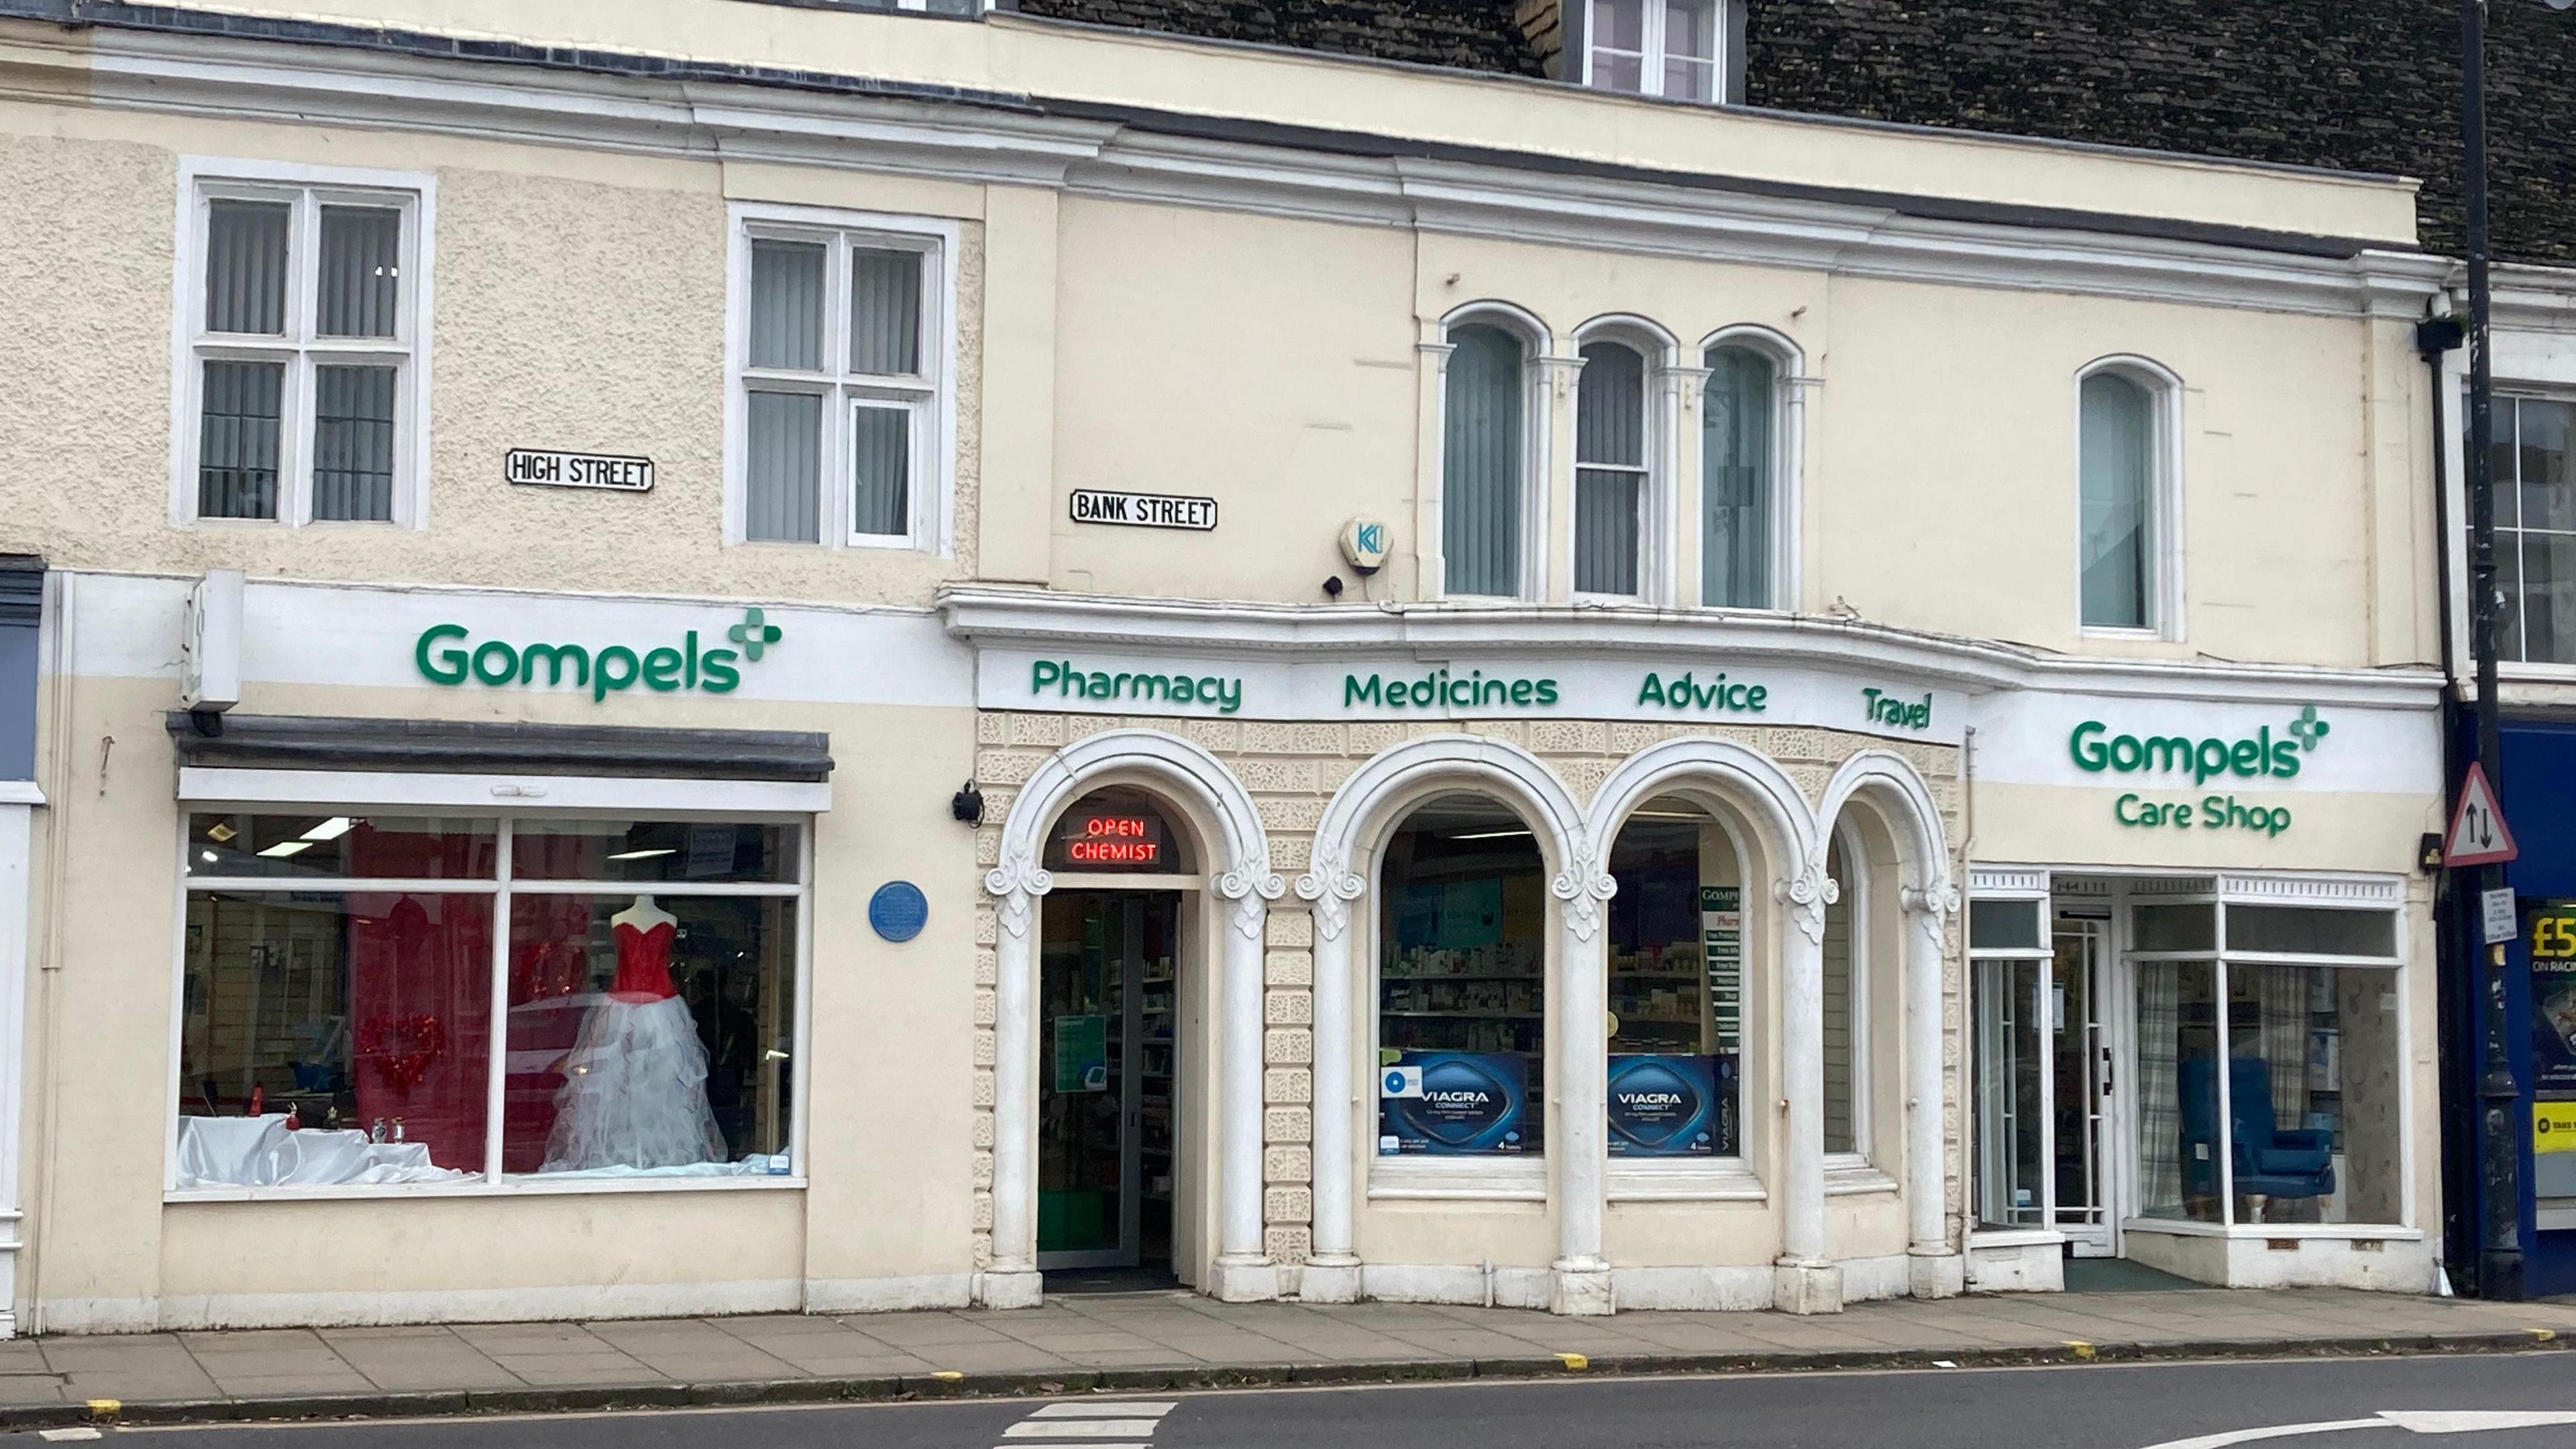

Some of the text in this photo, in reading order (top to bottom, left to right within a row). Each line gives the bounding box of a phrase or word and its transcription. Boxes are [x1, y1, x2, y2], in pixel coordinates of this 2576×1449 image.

[513, 454, 649, 486] HIGH STREET
[1077, 494, 1212, 525] BANK STREET
[415, 624, 741, 702] Gompels
[1032, 660, 1241, 713] Pharmacy
[1344, 669, 1558, 708] Medicines
[1639, 672, 1768, 712] Advice
[1864, 688, 1932, 729] Travel
[2070, 720, 2301, 785] Gompels
[1088, 818, 1144, 837] OPEN
[2116, 794, 2292, 838] Care Shop
[1071, 842, 1157, 861] CHEMIST
[2533, 961, 2548, 972] ON
[1421, 1091, 1489, 1102] VIAGRA
[1618, 1093, 1682, 1104] VIAGRA
[1721, 1097, 1729, 1150] VIAGRA
[1497, 1141, 1505, 1149] 4
